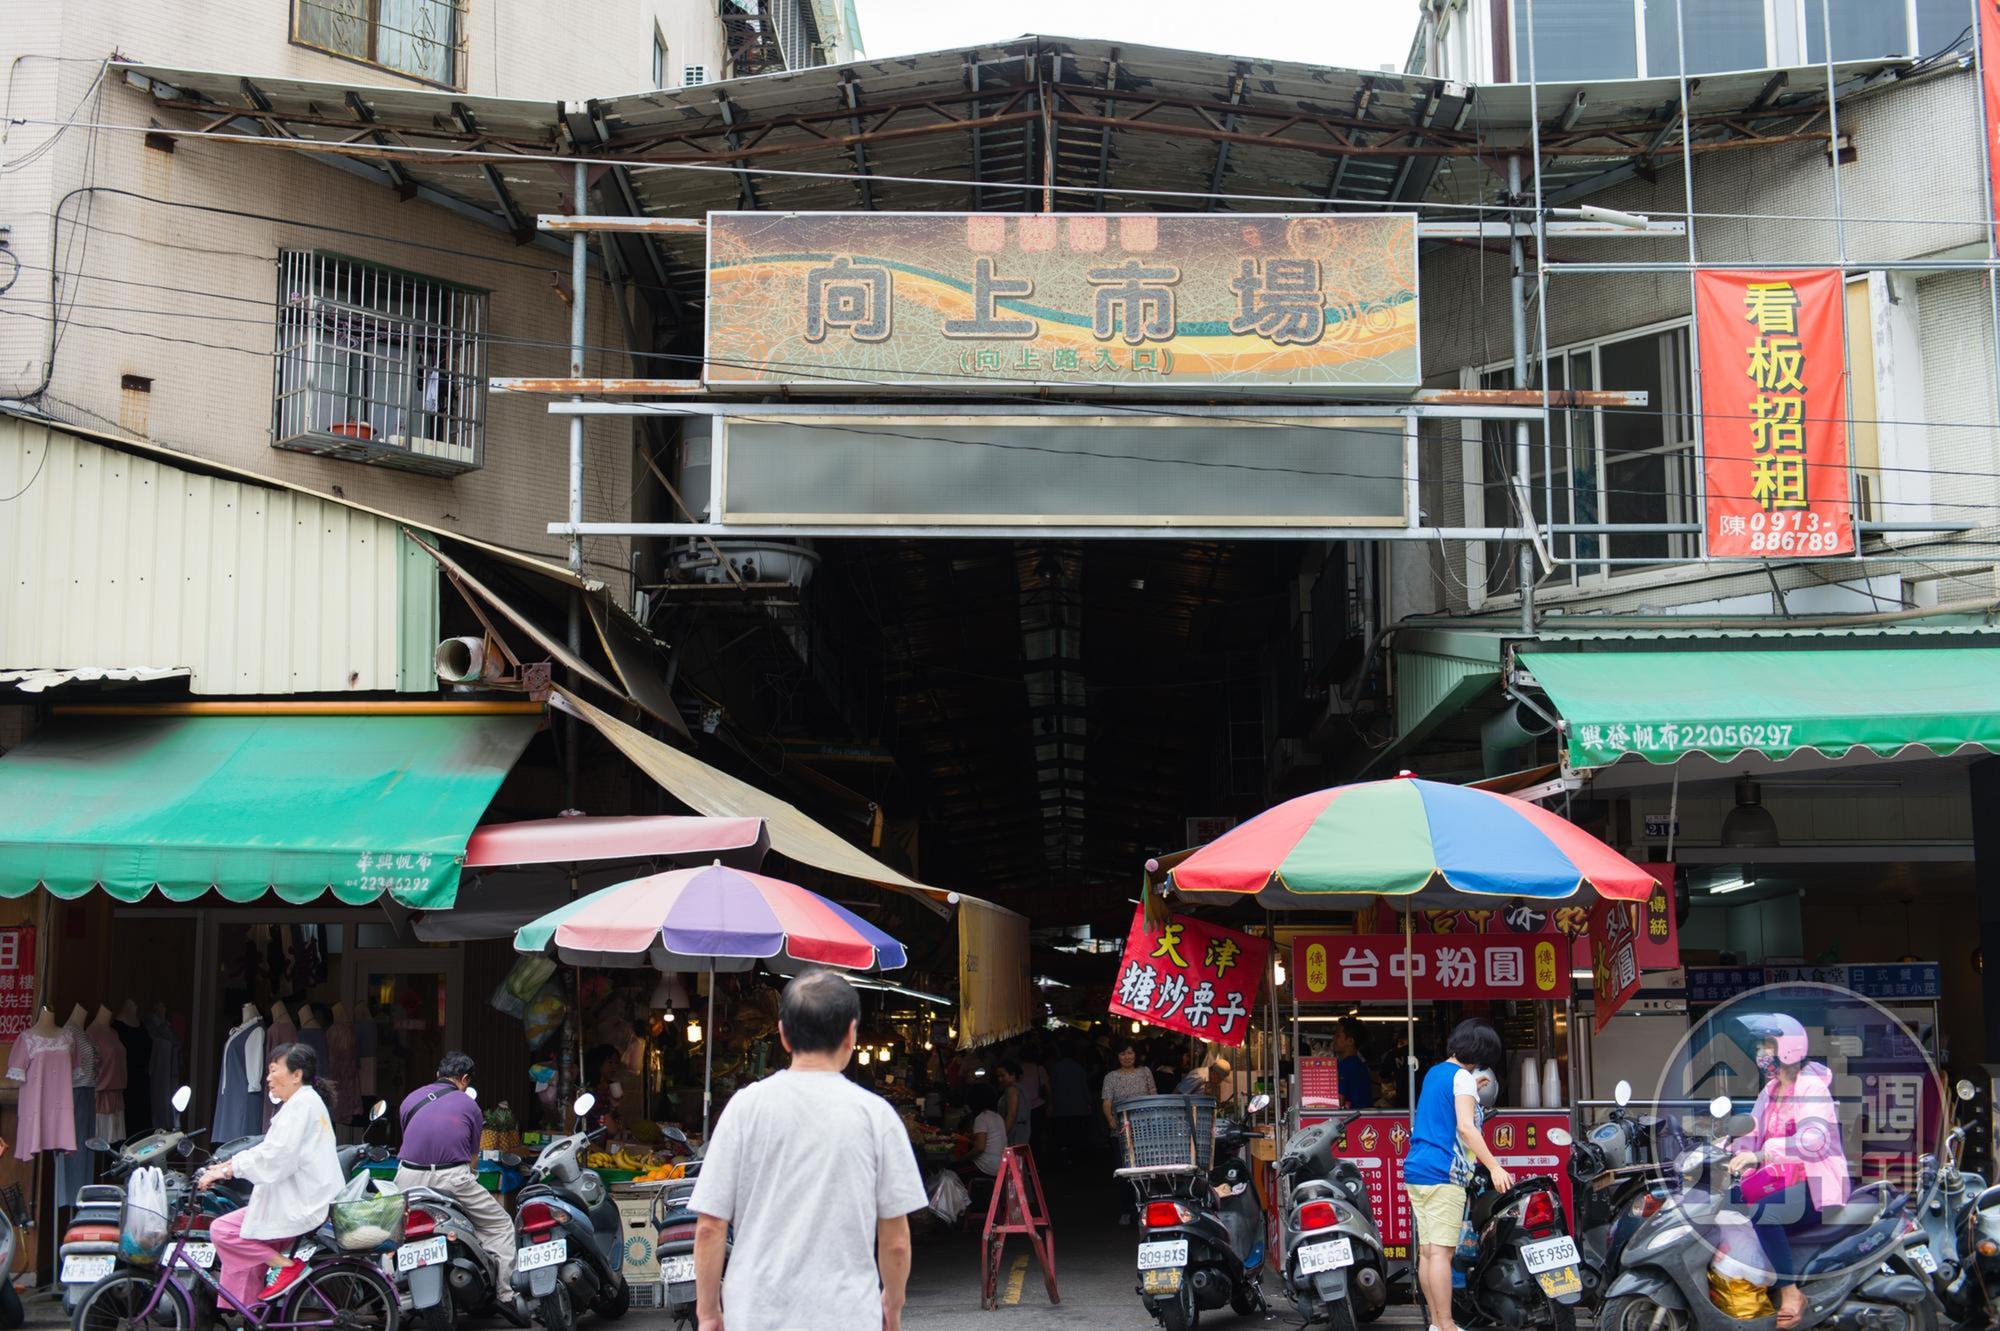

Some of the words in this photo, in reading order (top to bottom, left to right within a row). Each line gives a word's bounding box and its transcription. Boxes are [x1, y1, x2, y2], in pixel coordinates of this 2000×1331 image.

[803, 254, 1330, 346] 向上市場
[958, 347, 1175, 375] (向上路入口)
[1743, 281, 1810, 512] 看板招租
[1719, 514, 1747, 537] 陳
[1750, 512, 1833, 532] 0913-
[1750, 531, 1839, 552] 886789
[1649, 824, 1676, 836] 21
[1649, 895, 1669, 937] 傳統
[1150, 923, 1241, 978] 天津
[1308, 951, 1327, 985] 傳統
[1339, 946, 1525, 988] 台中粉圓
[1537, 949, 1555, 984] 傳統
[0, 993, 33, 1008] 先生
[1118, 960, 1247, 1034] 糖炒栗子
